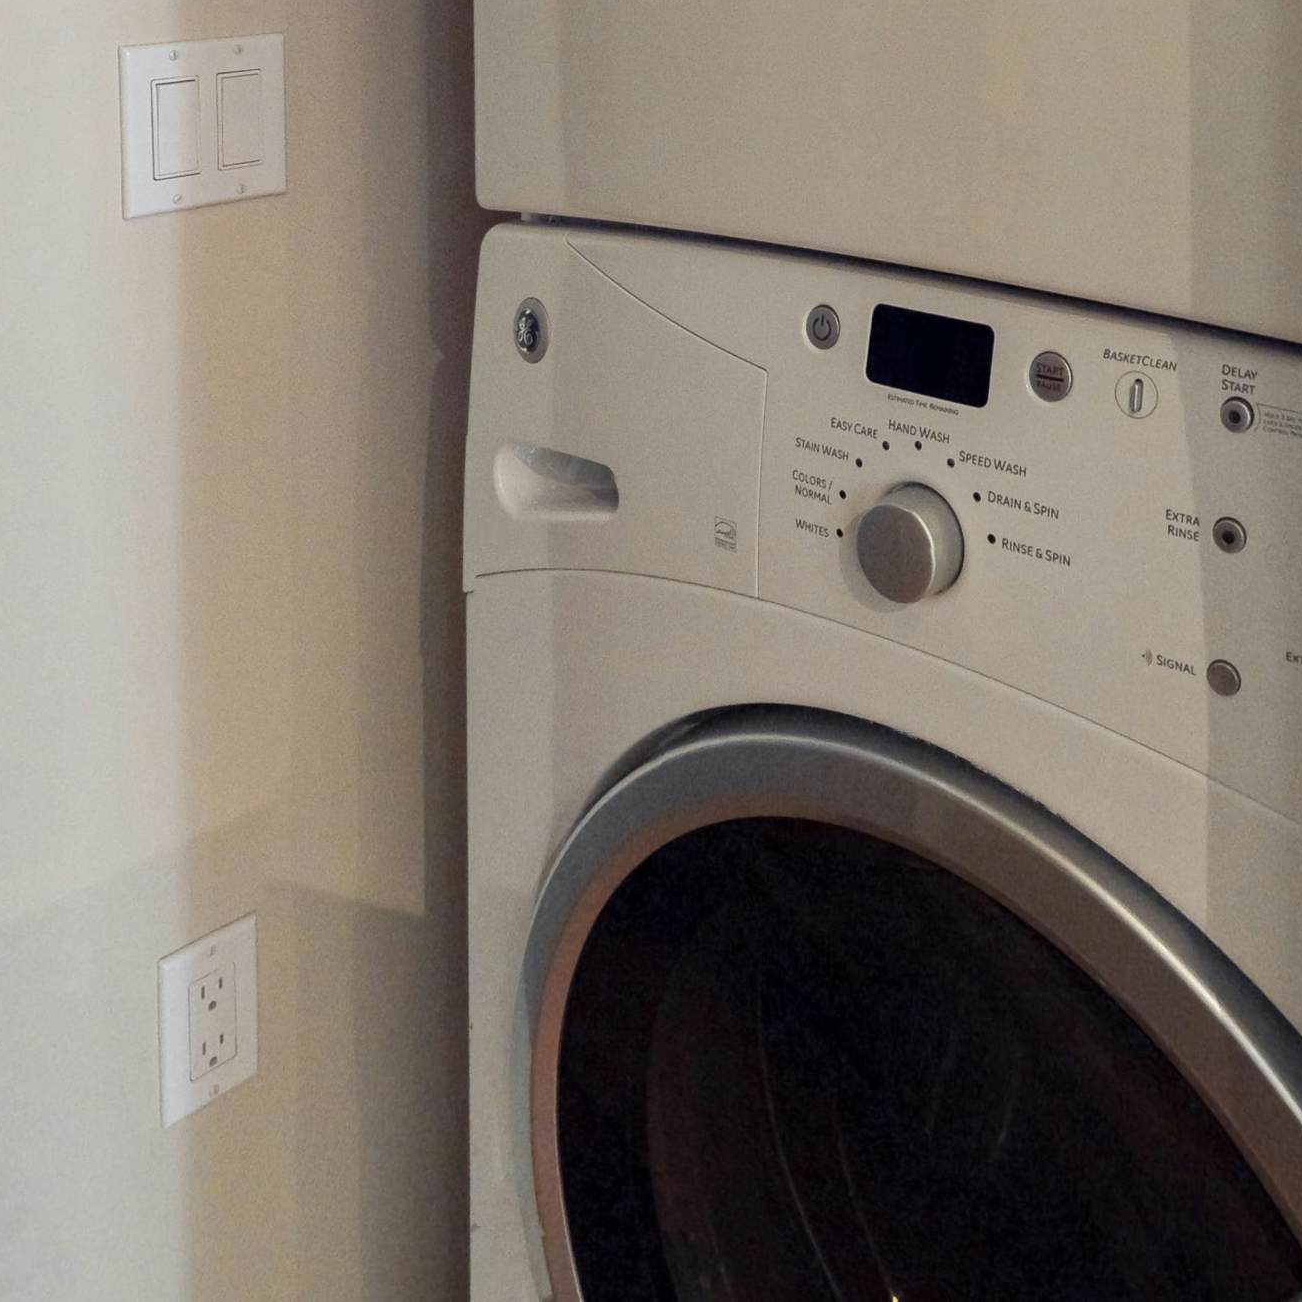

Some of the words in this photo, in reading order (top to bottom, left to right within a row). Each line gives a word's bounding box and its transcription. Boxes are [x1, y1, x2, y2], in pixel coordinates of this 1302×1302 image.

[1103, 348, 1178, 372] BASKETCLEAN
[1221, 364, 1258, 380] DELAY
[1221, 379, 1256, 395] START
[830, 418, 853, 431] EASY
[854, 423, 878, 438] CARE
[888, 419, 917, 436] HAND
[919, 426, 950, 443] WASH
[795, 437, 820, 453] STAIN
[822, 444, 849, 460] WASH
[959, 450, 991, 468] SPEED
[994, 459, 1027, 477] WASH
[792, 470, 826, 489] COLORS
[795, 485, 831, 505] NORMAL
[987, 491, 1021, 510] DRAIN
[1033, 502, 1059, 519] SPIN
[795, 518, 829, 538] WHITES
[1165, 509, 1200, 527] EXTRA
[1167, 525, 1200, 542] RINSE
[1001, 538, 1033, 557] RINSE
[1045, 549, 1071, 567] SPIN
[1155, 654, 1197, 677] SIGNAL
